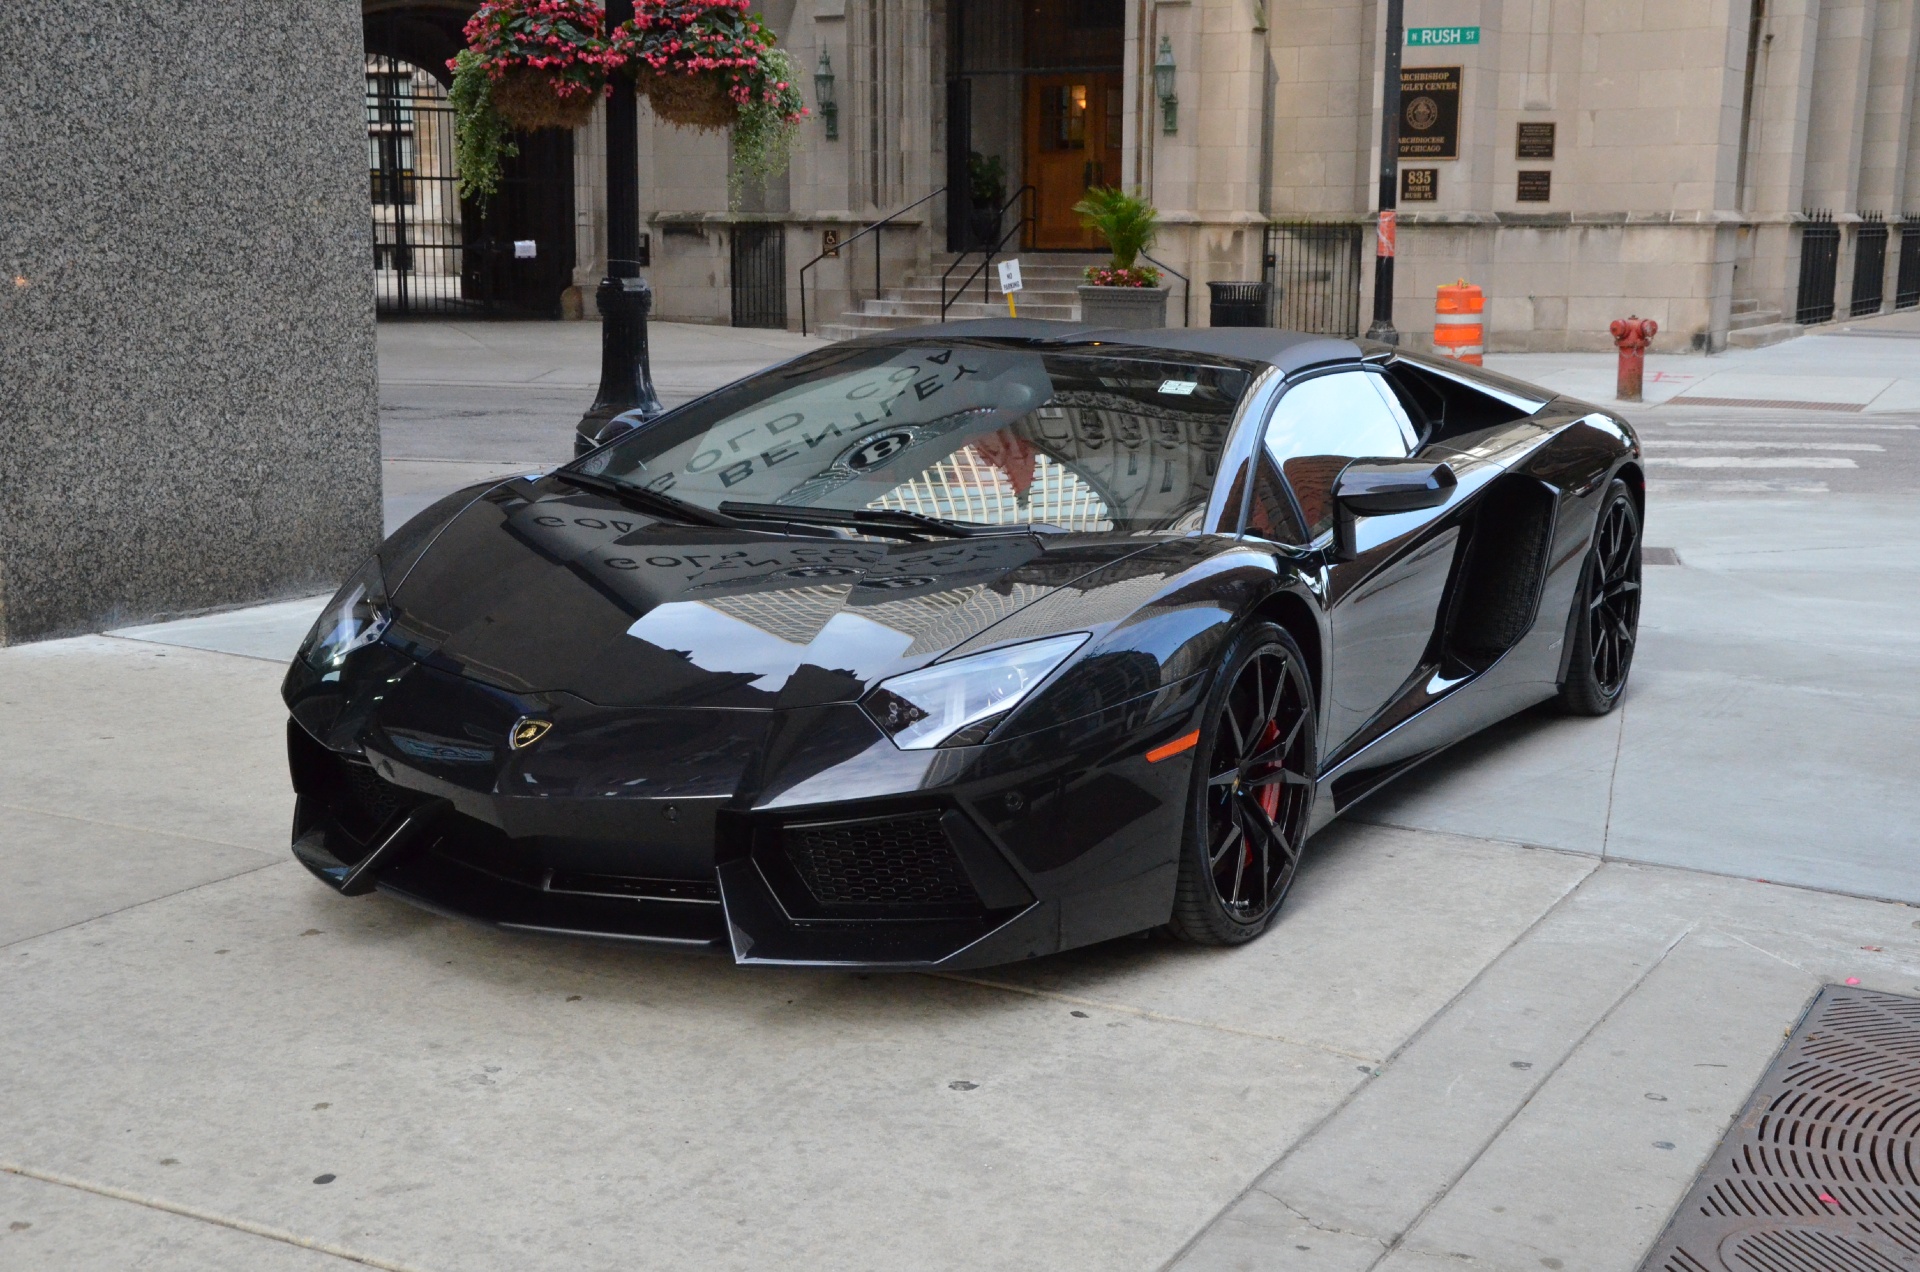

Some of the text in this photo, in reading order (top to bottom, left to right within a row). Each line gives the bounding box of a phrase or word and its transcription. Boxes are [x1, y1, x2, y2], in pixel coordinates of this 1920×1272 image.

[1411, 29, 1475, 43] N RUSH ST
[1425, 82, 1458, 90] CENTER
[1400, 145, 1409, 153] OF
[1408, 170, 1431, 185] 835
